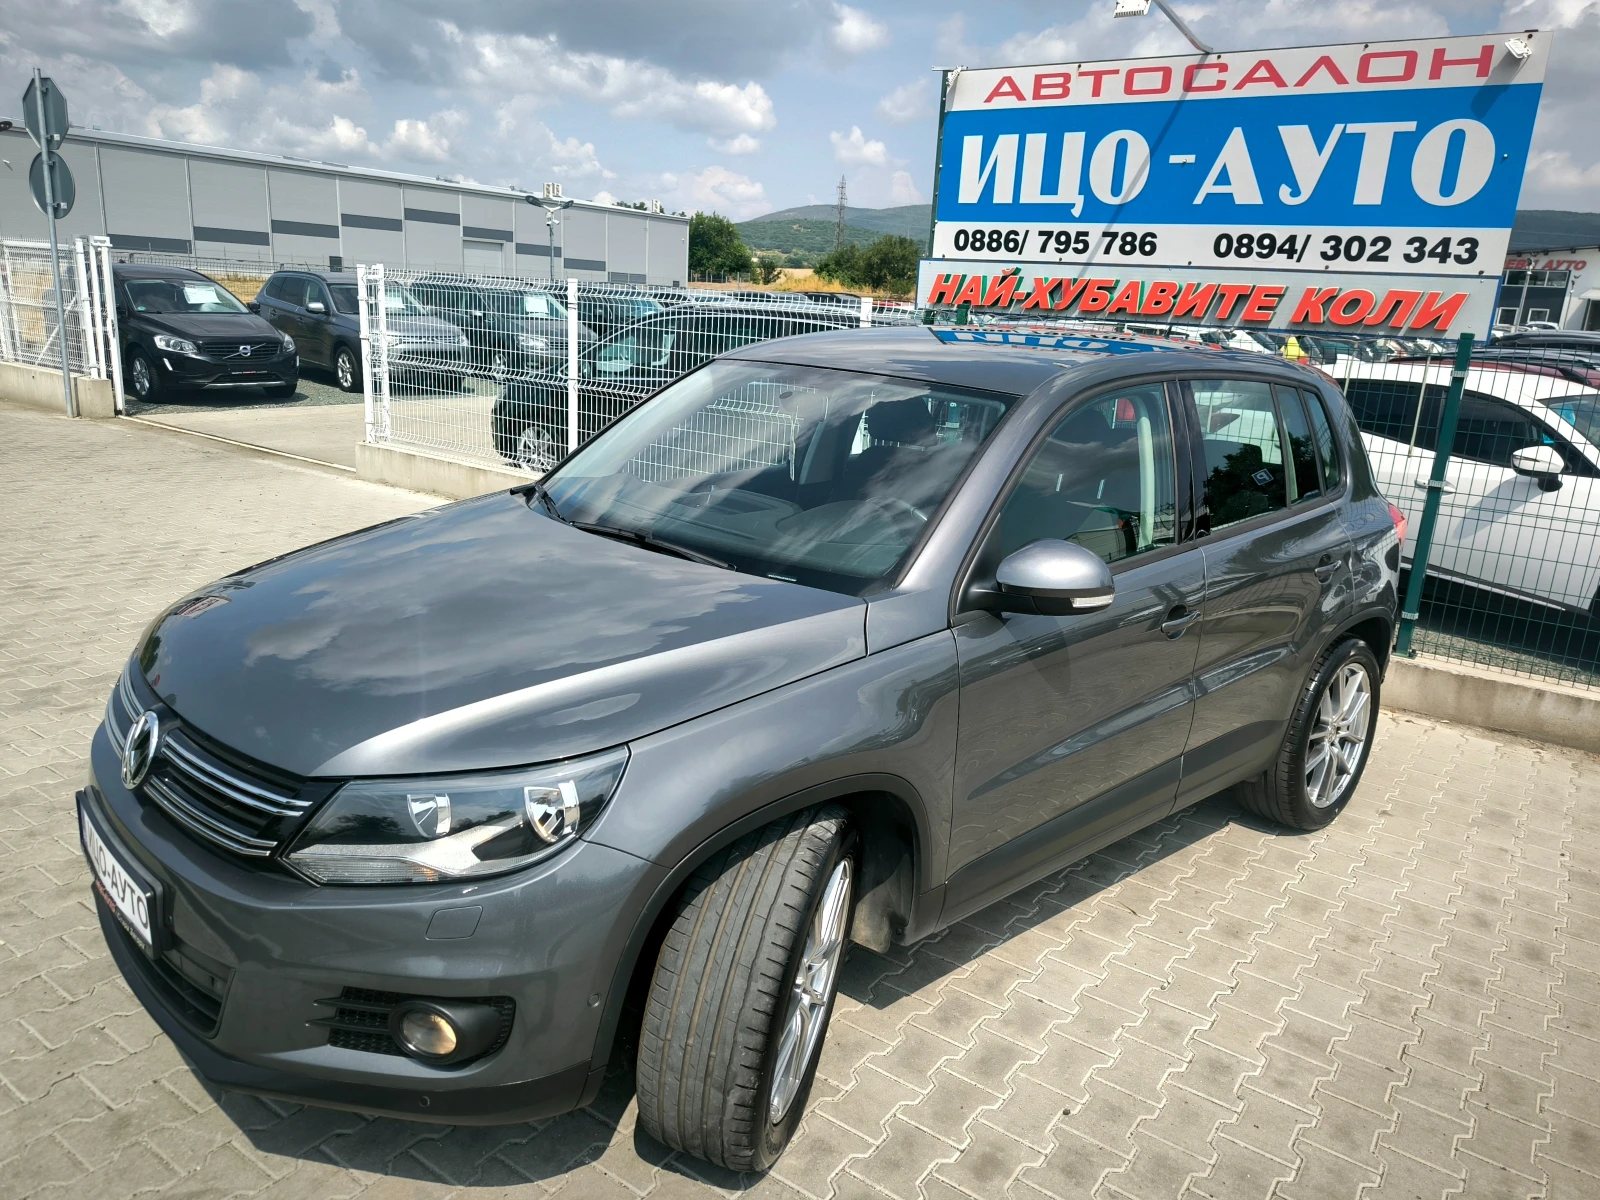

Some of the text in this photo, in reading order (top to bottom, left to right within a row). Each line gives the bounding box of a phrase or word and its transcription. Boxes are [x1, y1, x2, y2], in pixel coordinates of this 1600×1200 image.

[983, 44, 1495, 104] АВТОСАЛОН
[953, 229, 1159, 257] 0886/ 795 786
[1213, 232, 1480, 265] 0894/ 302 343
[1542, 259, 1588, 271] АУТО
[926, 267, 1470, 331] НАЙ-ХУБАВИТЕ КОЛИ
